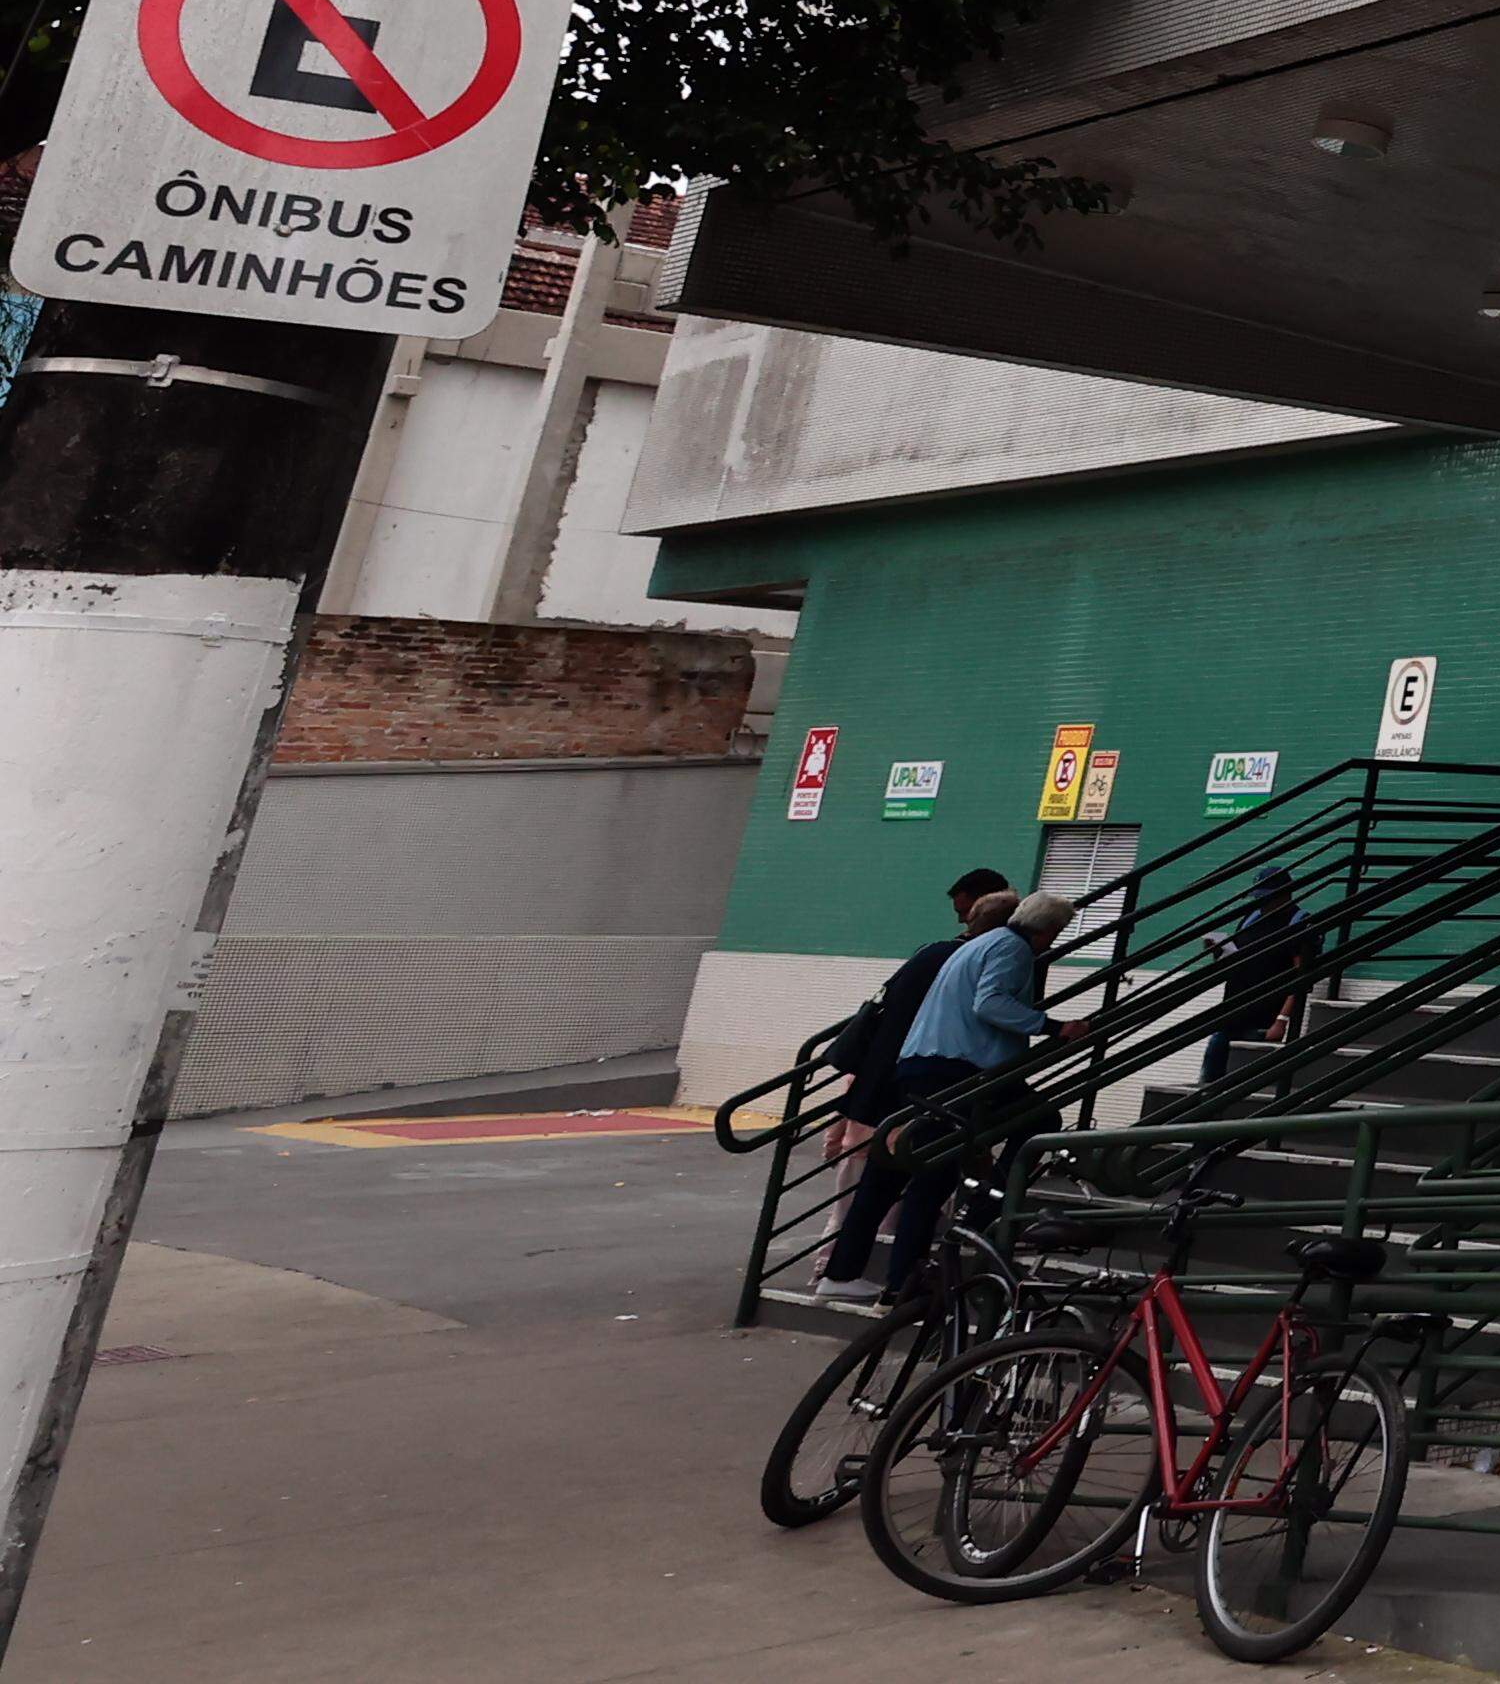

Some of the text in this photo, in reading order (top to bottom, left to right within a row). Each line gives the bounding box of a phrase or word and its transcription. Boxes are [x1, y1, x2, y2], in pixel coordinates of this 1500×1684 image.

[154, 169, 414, 246] ÔNIBUS
[53, 232, 469, 316] CAMINHÕES
[1400, 676, 1418, 711] E
[1376, 745, 1421, 757] AMBULÂNCIA
[893, 766, 920, 788] UPA
[1213, 756, 1272, 782] UPA 24h
